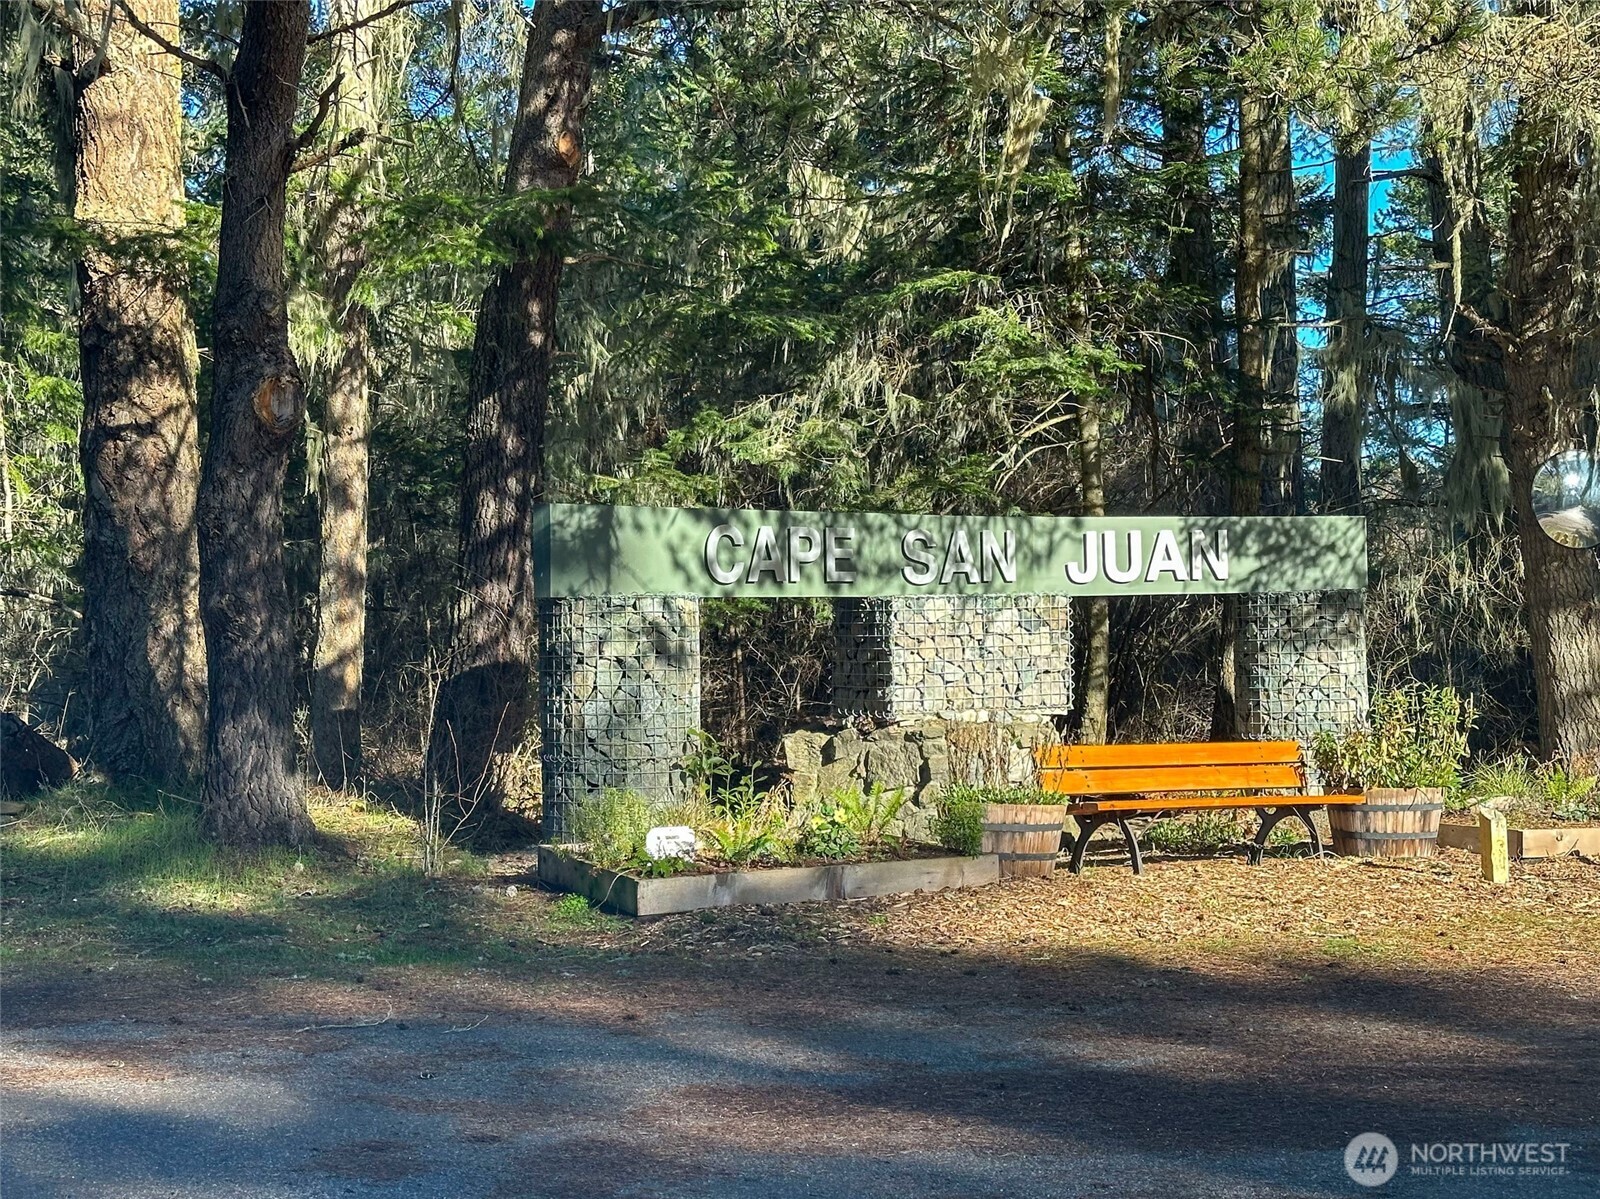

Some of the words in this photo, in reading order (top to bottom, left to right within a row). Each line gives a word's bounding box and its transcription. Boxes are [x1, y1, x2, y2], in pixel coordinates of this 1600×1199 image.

[704, 524, 857, 585] CAPE
[901, 529, 1018, 586] SAN
[1064, 529, 1230, 584] JUAN
